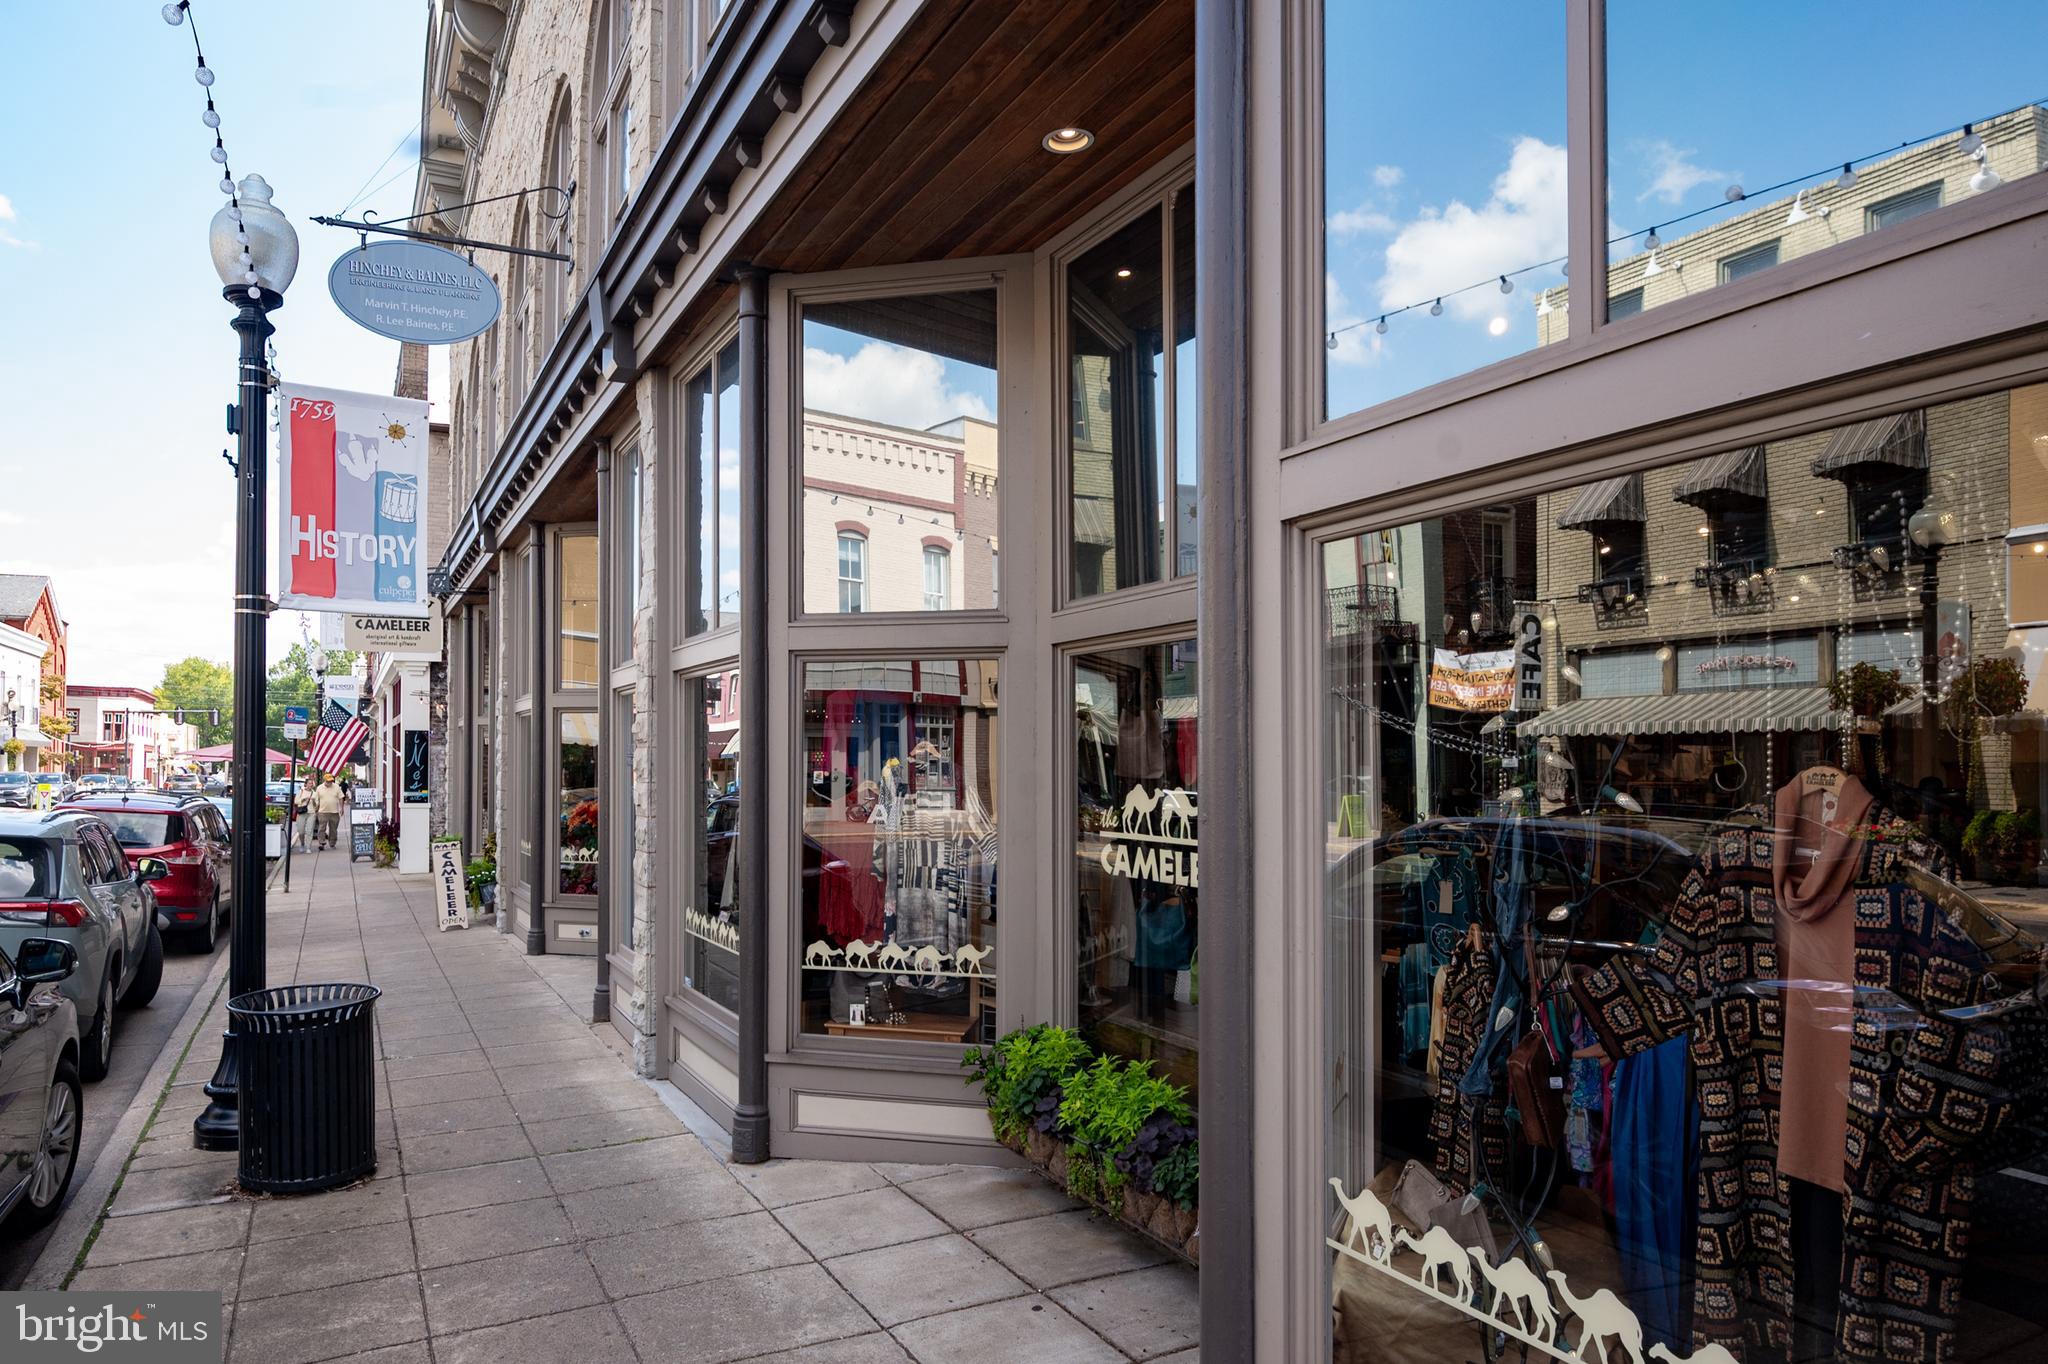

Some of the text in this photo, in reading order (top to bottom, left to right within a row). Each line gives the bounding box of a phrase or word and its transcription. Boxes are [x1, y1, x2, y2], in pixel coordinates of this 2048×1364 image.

[349, 260, 482, 290] HINCHEY & BAINES, PLC
[349, 277, 405, 293] ENGINEERING
[365, 298, 469, 319] Marvin T. Hinchey, P.E.
[376, 314, 457, 332] R. Lee Baines, P.E.
[291, 399, 336, 421] 1759
[291, 514, 416, 568] HISTORY
[379, 583, 416, 597] culpeper
[355, 618, 431, 632] CAMELEER
[1100, 805, 1119, 828] the
[1100, 843, 1199, 888] CAMELE
[441, 851, 458, 917] CAMELEER
[441, 916, 466, 925] OPEN
